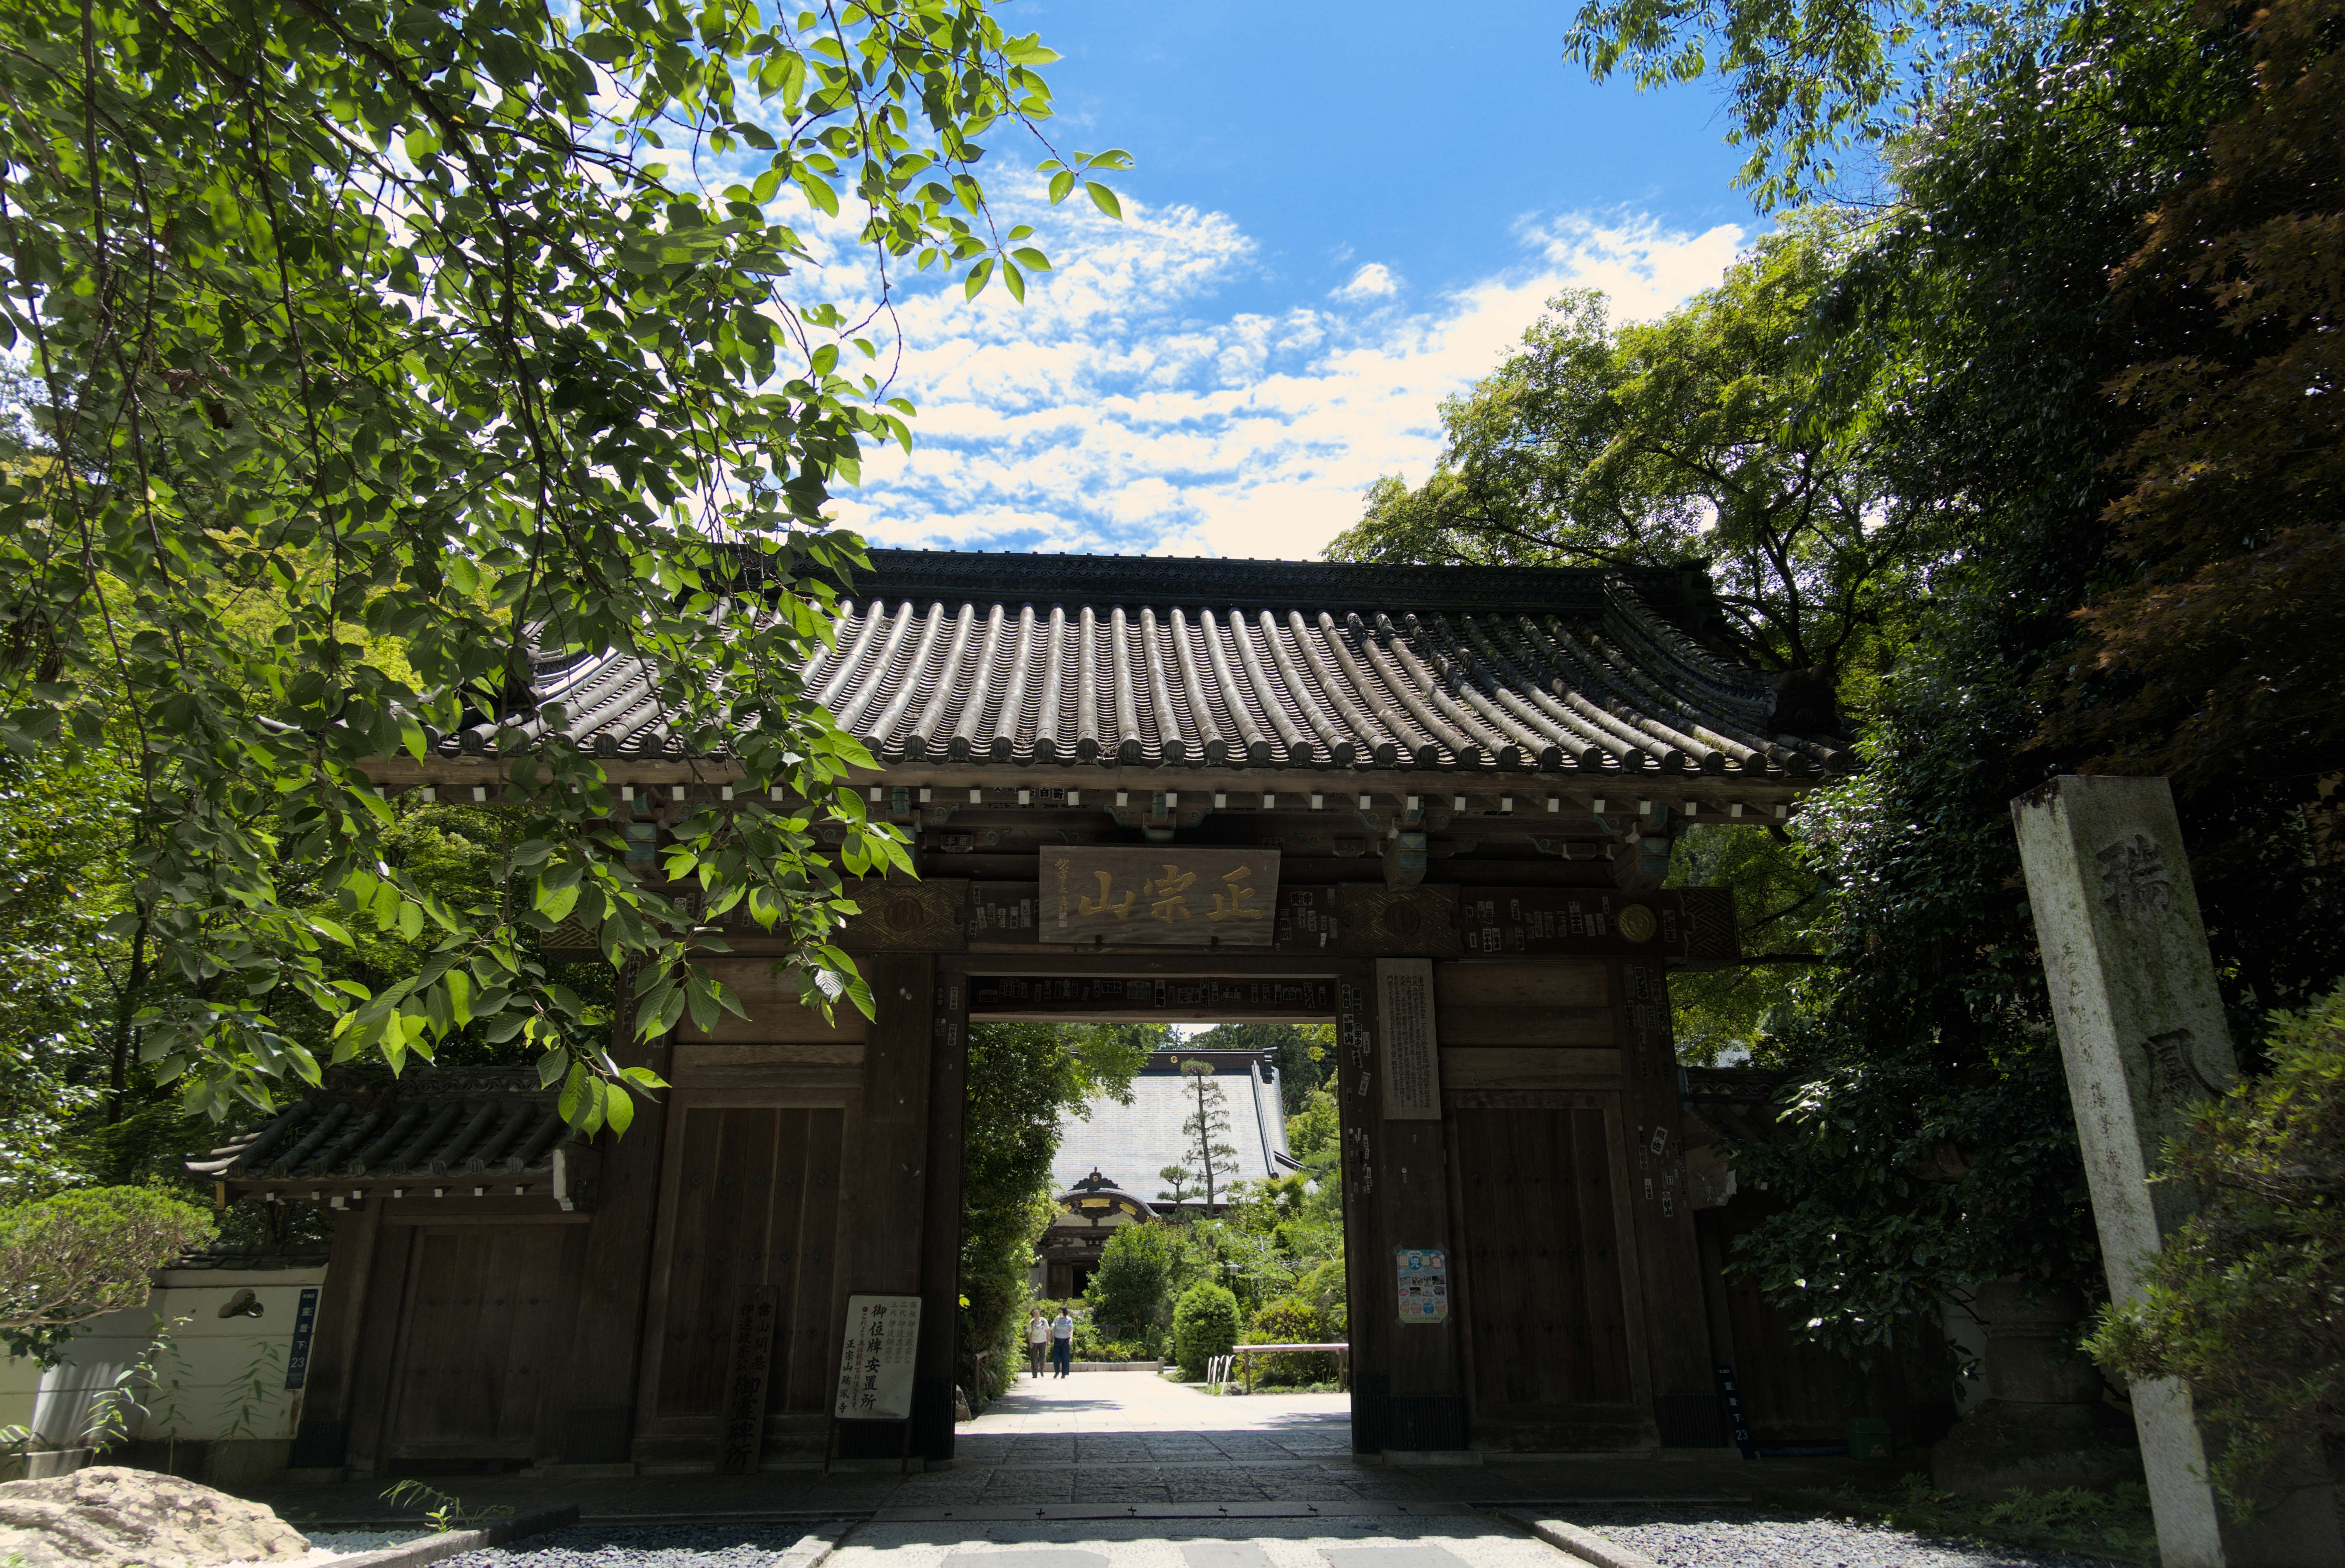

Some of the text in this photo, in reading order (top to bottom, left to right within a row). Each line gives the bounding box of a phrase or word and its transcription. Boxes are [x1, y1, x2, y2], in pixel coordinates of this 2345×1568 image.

[1078, 865, 1263, 924] 正宗山
[1400, 1256, 1442, 1268] 園児募集
[291, 1357, 305, 1368] 23
[860, 1304, 887, 1411] 御位牌安置所
[838, 1339, 856, 1413] 正宗山瑞鳳寺
[1735, 1430, 1748, 1440] 23
